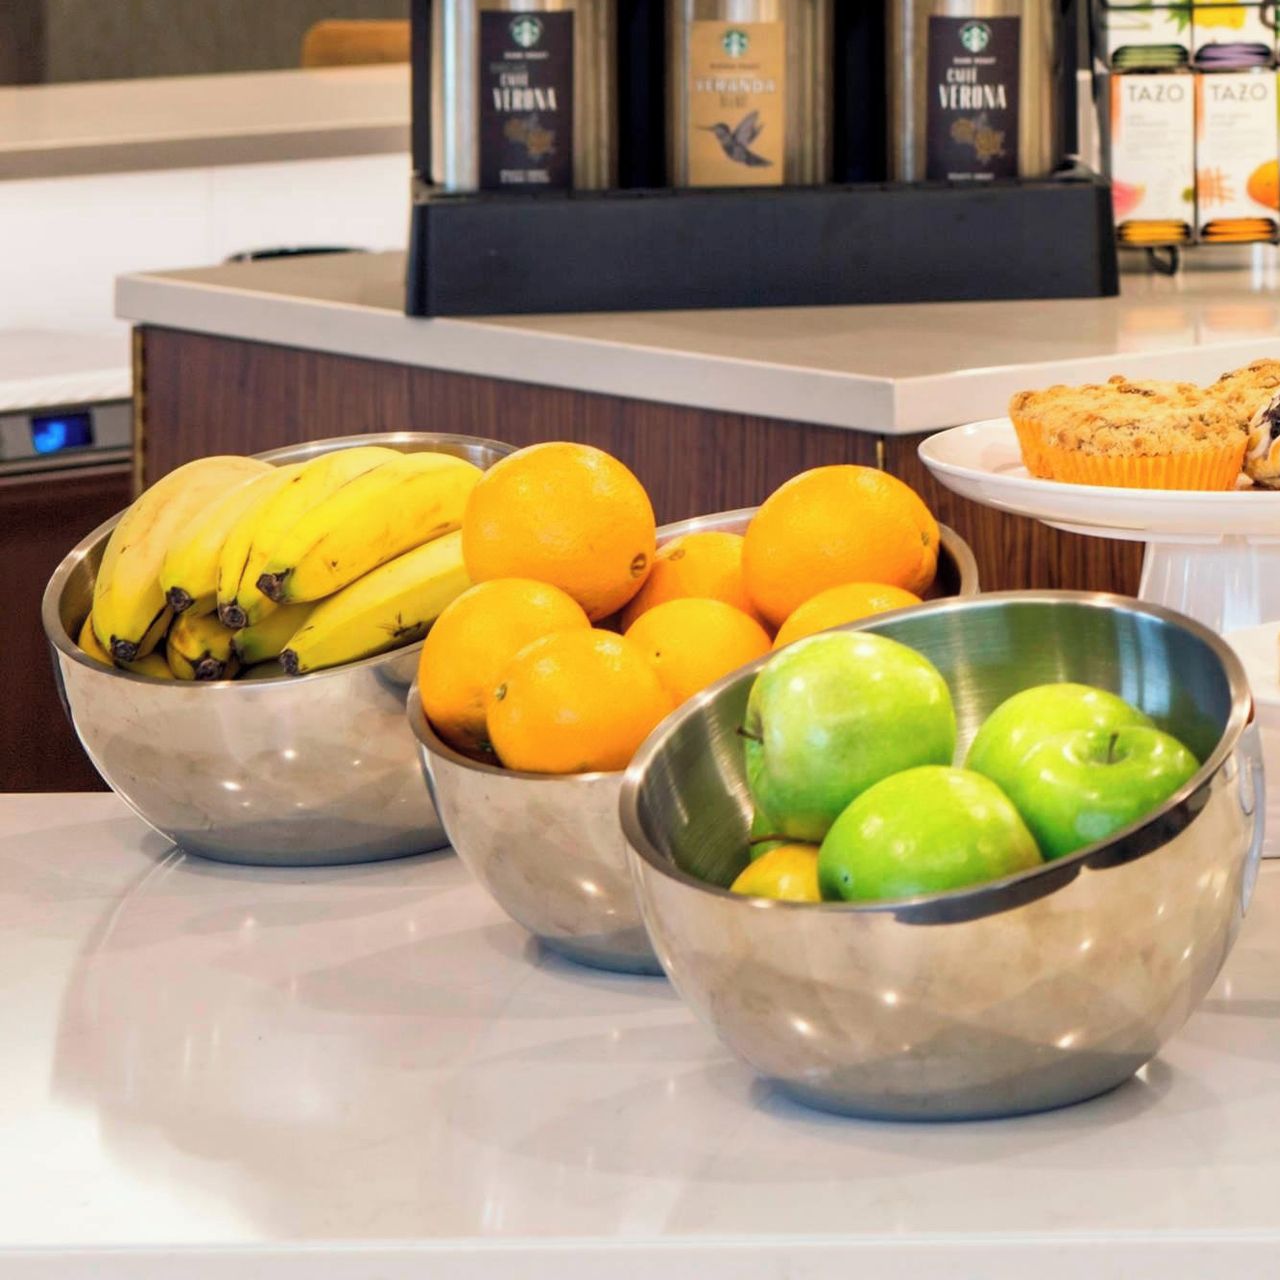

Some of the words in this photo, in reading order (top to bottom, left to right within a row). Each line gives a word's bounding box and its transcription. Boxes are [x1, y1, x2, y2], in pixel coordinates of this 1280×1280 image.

[492, 86, 558, 112] VERONA
[938, 83, 1008, 111] VERONA
[1127, 84, 1185, 103] TAZO
[1211, 82, 1268, 102] TAZO
